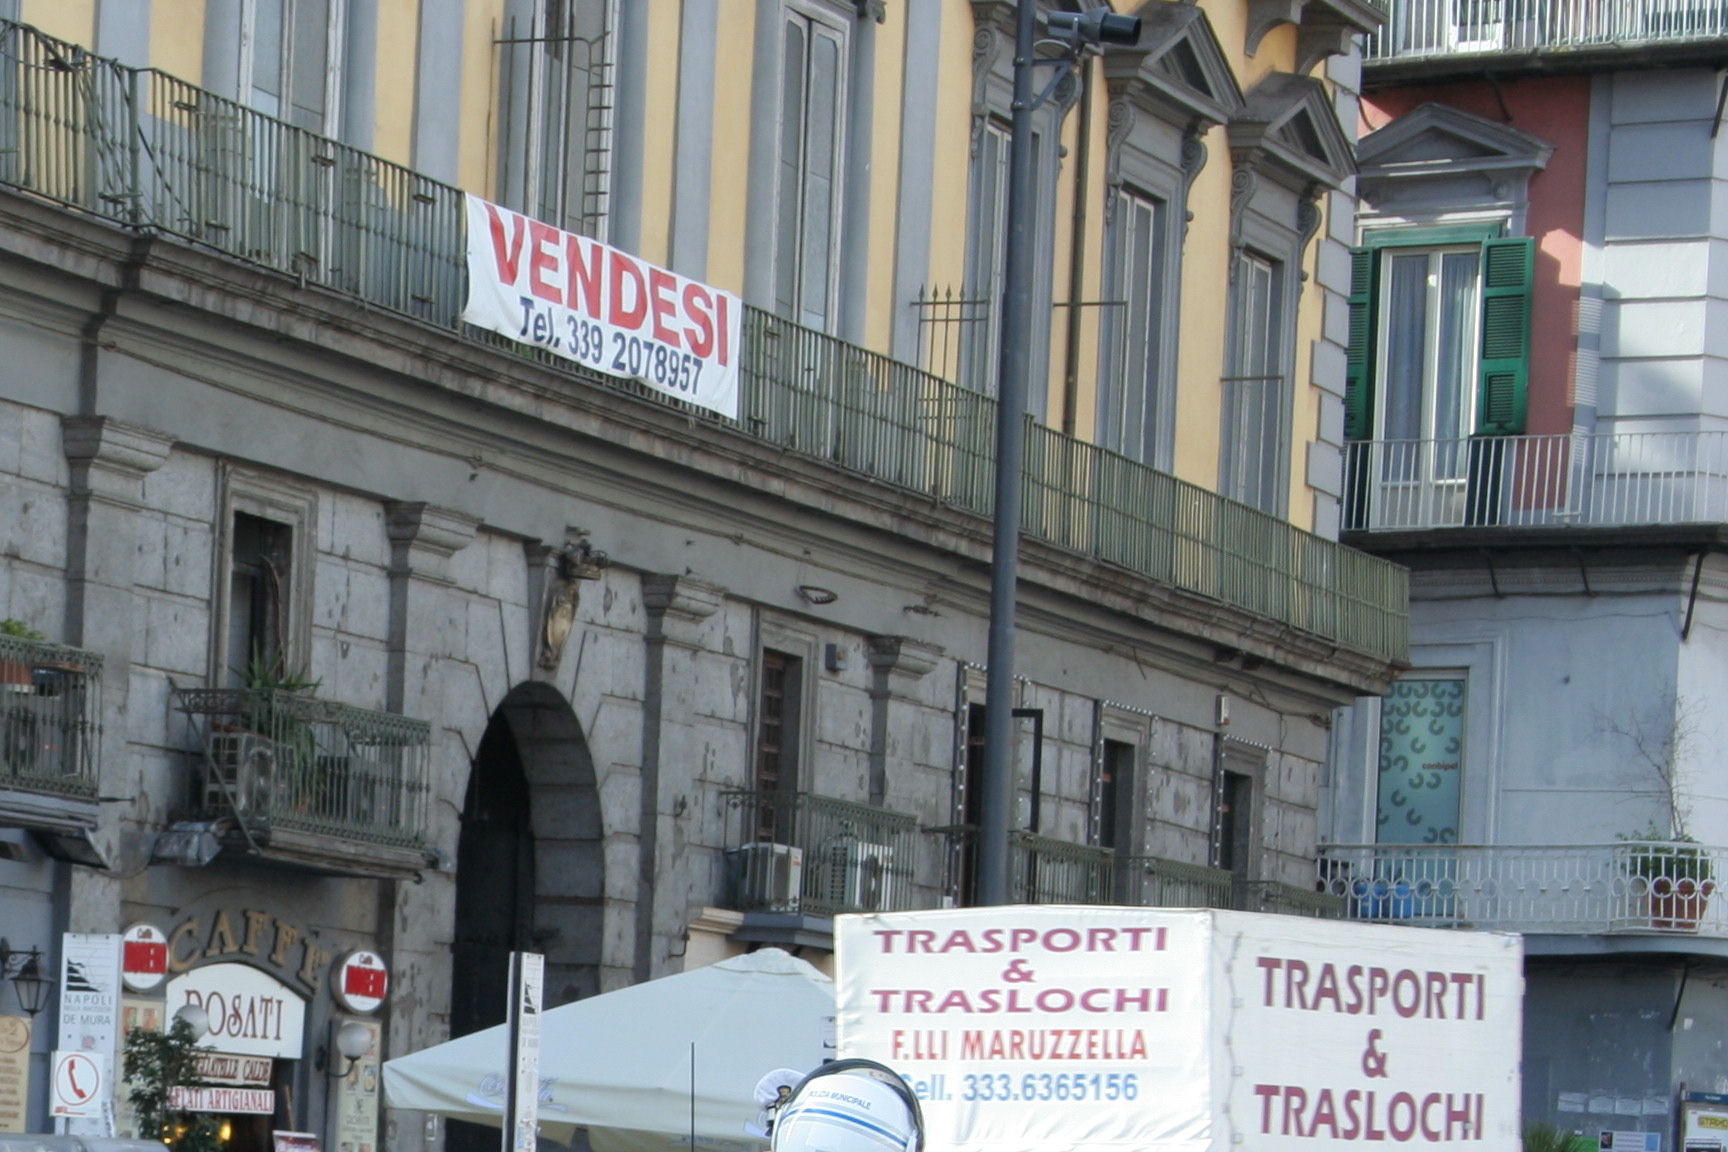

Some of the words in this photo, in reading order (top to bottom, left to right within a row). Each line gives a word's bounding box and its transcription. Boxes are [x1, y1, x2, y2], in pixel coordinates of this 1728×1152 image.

[483, 202, 728, 368] VENDESI
[519, 295, 561, 348] Tel.
[566, 314, 603, 364] 339
[611, 331, 703, 395] 2078957
[873, 928, 1168, 953] TRASPORTI
[1003, 959, 1036, 983] &
[64, 994, 112, 1006] NAPOLI
[871, 988, 1170, 1014] TRASLOCHI
[1256, 956, 1485, 1021] TRASPORTI
[63, 1014, 76, 1024] DE
[80, 1015, 111, 1025] MURA
[891, 1029, 948, 1061] F.LLI
[960, 1029, 1149, 1061] MARUZZELLA
[1363, 1028, 1388, 1078] &
[208, 1089, 275, 1112] ARTIGIANALI
[830, 1090, 872, 1111] MUNICIPALE
[963, 1073, 1139, 1101] 333.6365156
[1254, 1084, 1484, 1142] TRASLOCHI
